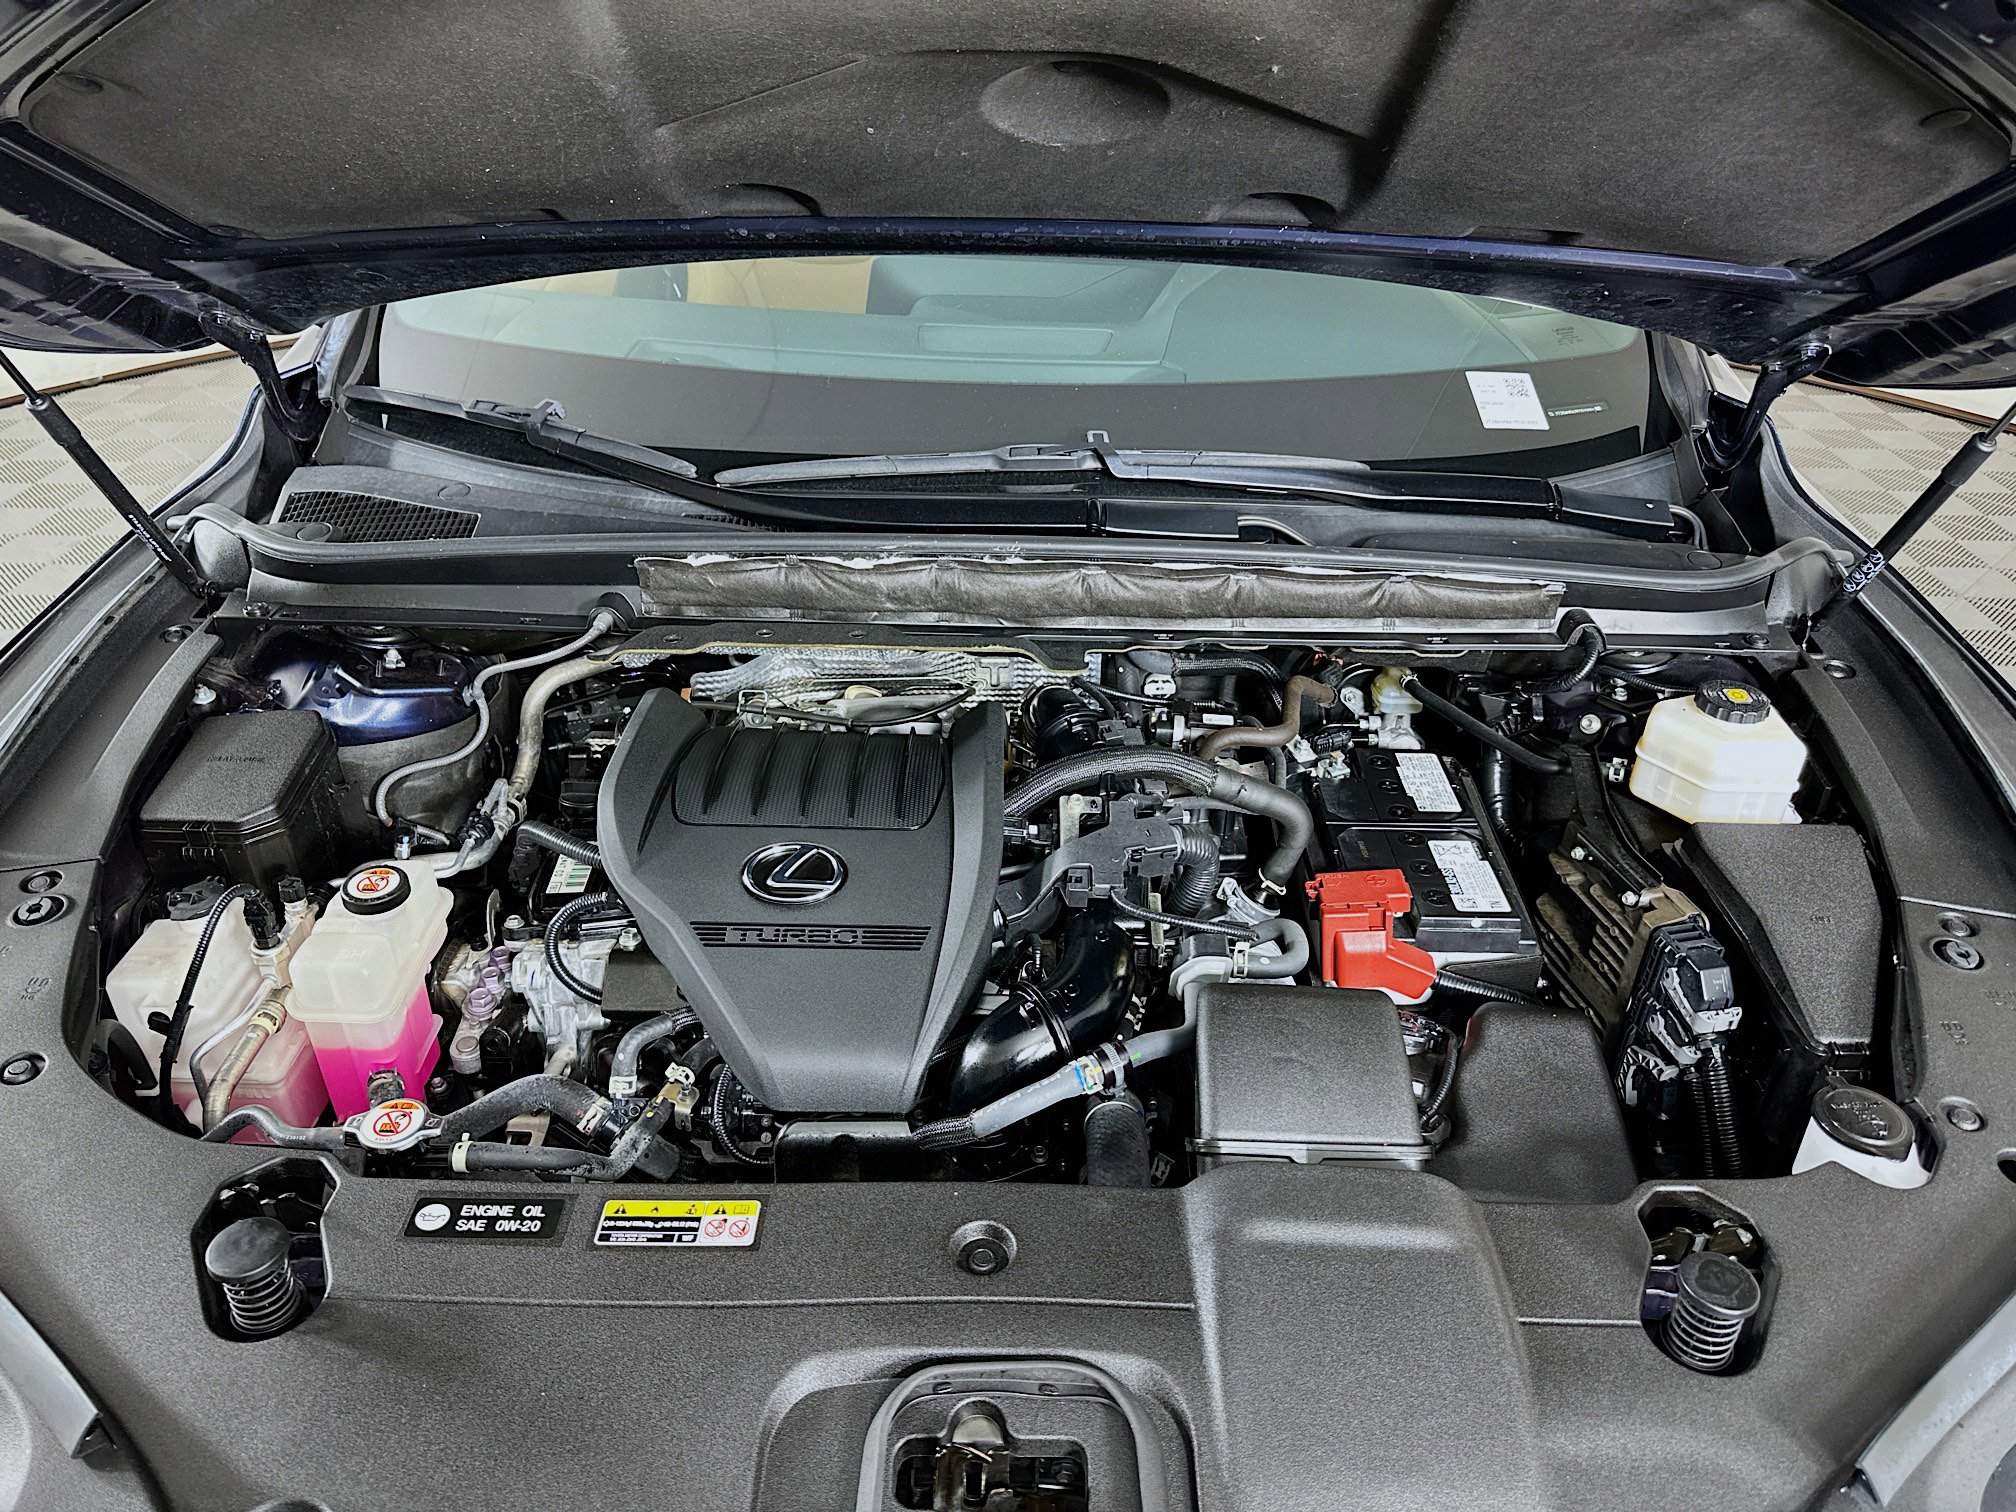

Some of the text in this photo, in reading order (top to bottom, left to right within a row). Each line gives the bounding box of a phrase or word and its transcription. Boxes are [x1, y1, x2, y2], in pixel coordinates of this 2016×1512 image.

[730, 926, 859, 945] TURBO
[460, 1204, 546, 1218] ENGINE OIL
[454, 1219, 542, 1233] SAE 0W-20
